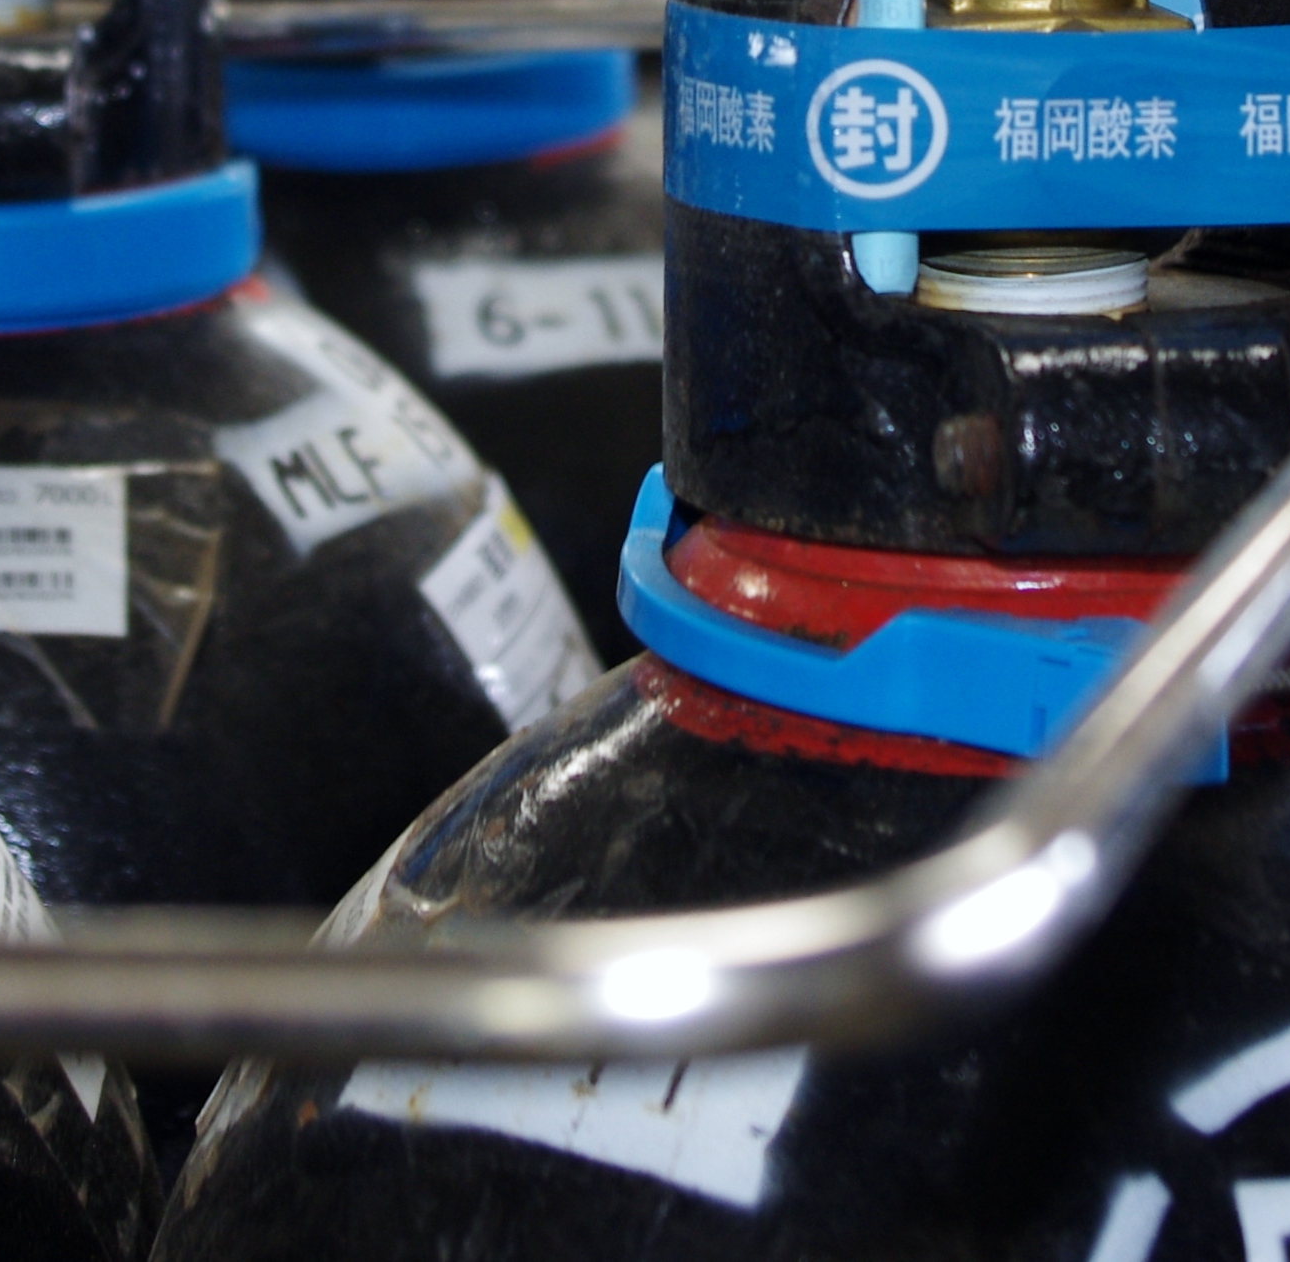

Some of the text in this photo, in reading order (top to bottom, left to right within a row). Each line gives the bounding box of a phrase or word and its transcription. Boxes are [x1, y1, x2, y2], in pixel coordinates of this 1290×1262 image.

[677, 76, 776, 153] 福岡酸素
[993, 96, 1177, 162] 福岡酸素
